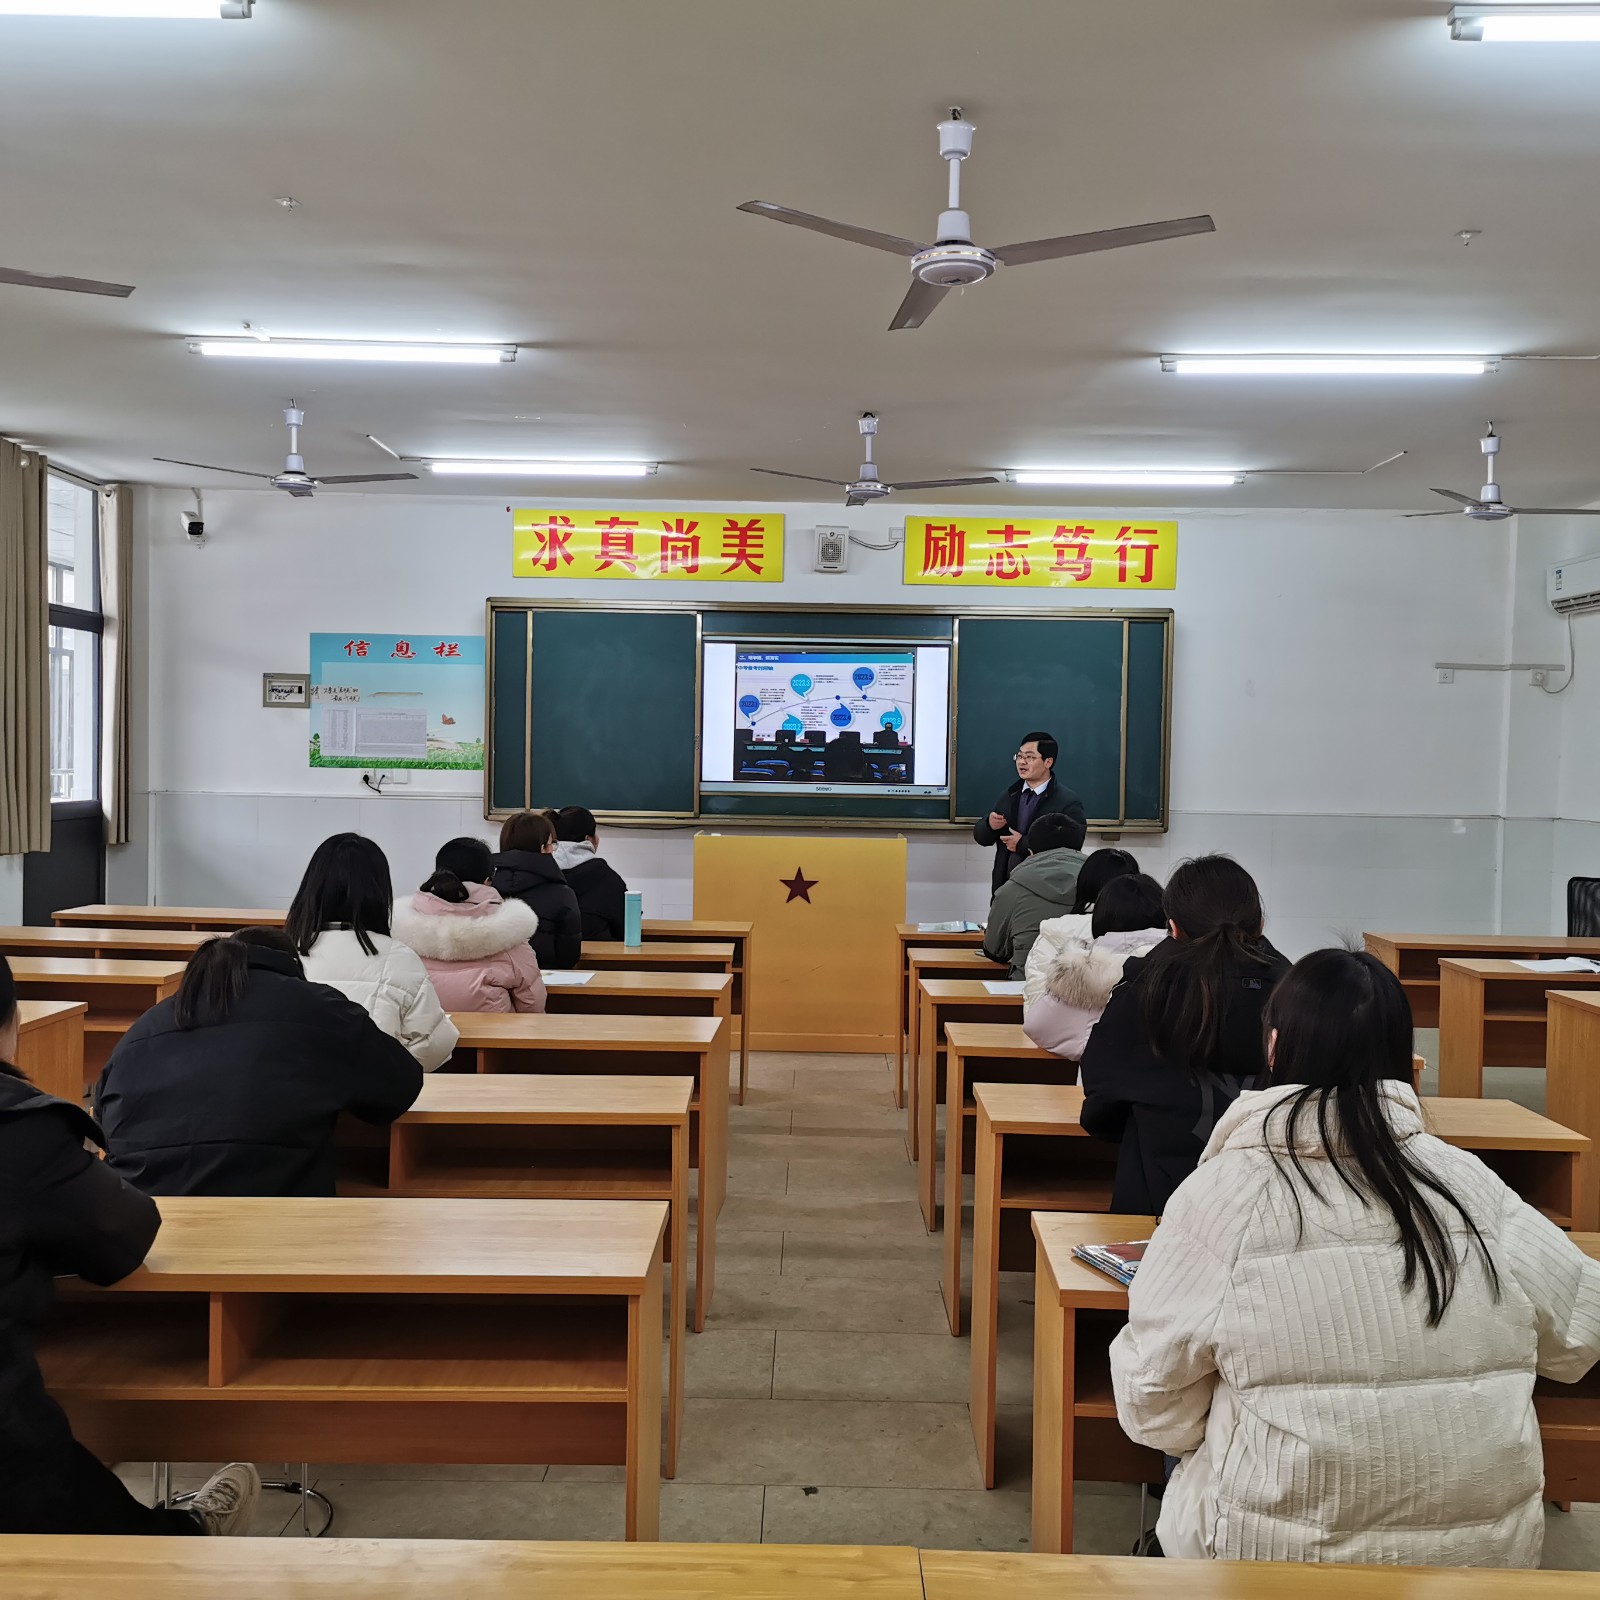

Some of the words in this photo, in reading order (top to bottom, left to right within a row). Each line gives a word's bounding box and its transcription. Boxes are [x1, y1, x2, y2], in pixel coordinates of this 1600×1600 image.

[532, 516, 764, 576] 求真尚美
[922, 523, 1159, 583] 励志笃行
[343, 639, 463, 659] 信息栏
